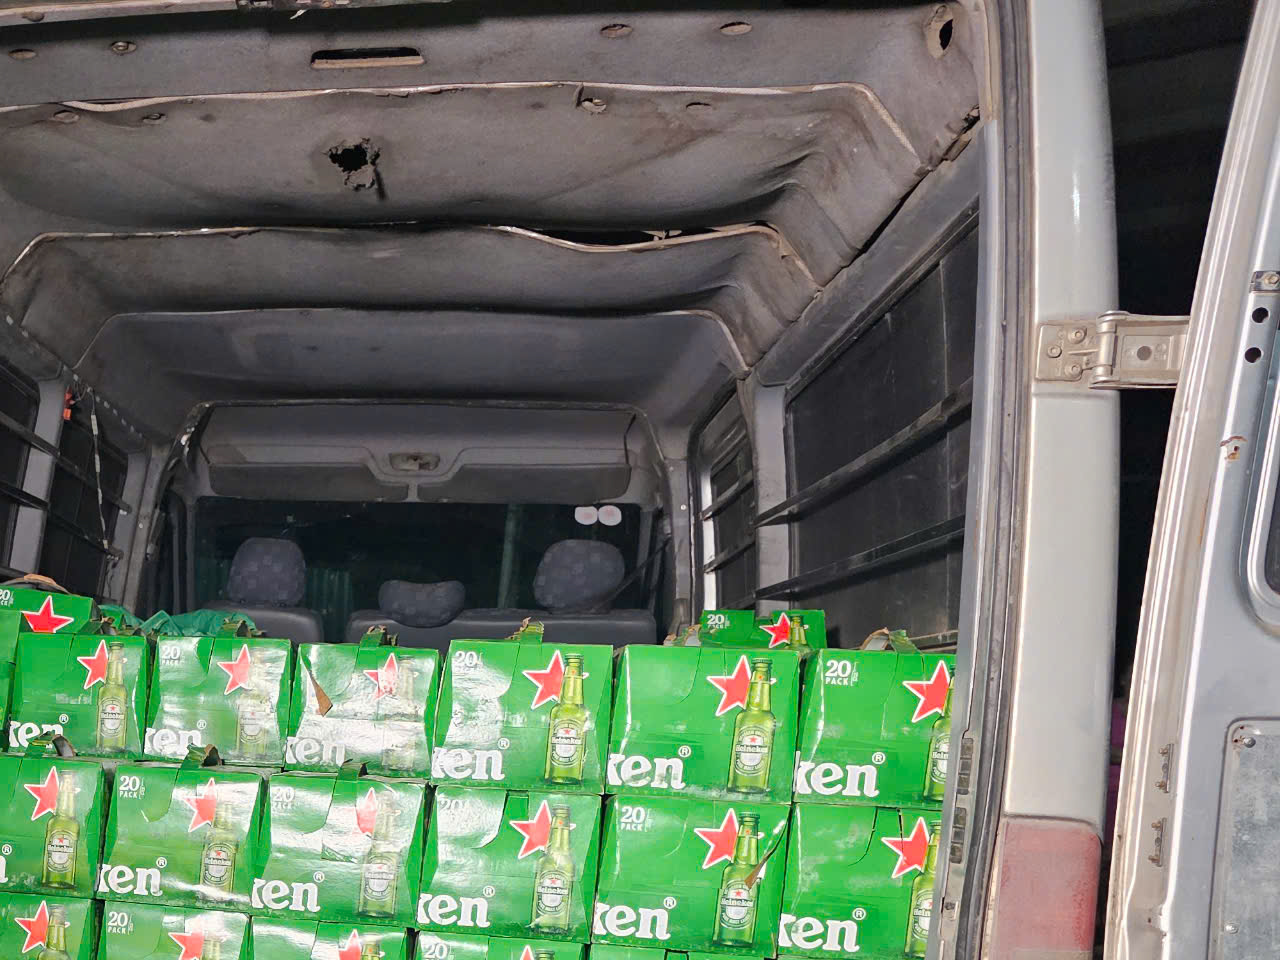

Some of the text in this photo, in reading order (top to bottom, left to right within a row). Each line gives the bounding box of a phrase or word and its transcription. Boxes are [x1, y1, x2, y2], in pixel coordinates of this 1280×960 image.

[707, 614, 725, 625] 20
[162, 645, 181, 659] 20
[455, 651, 478, 666] 20
[825, 660, 851, 677] 20
[825, 677, 849, 685] PACK
[120, 776, 140, 790] 20
[120, 790, 139, 799] PACK
[621, 806, 645, 823] 20
[621, 823, 643, 831] PACK
[108, 912, 128, 926] 20
[108, 926, 127, 934] PACK
[424, 943, 448, 959] 20
